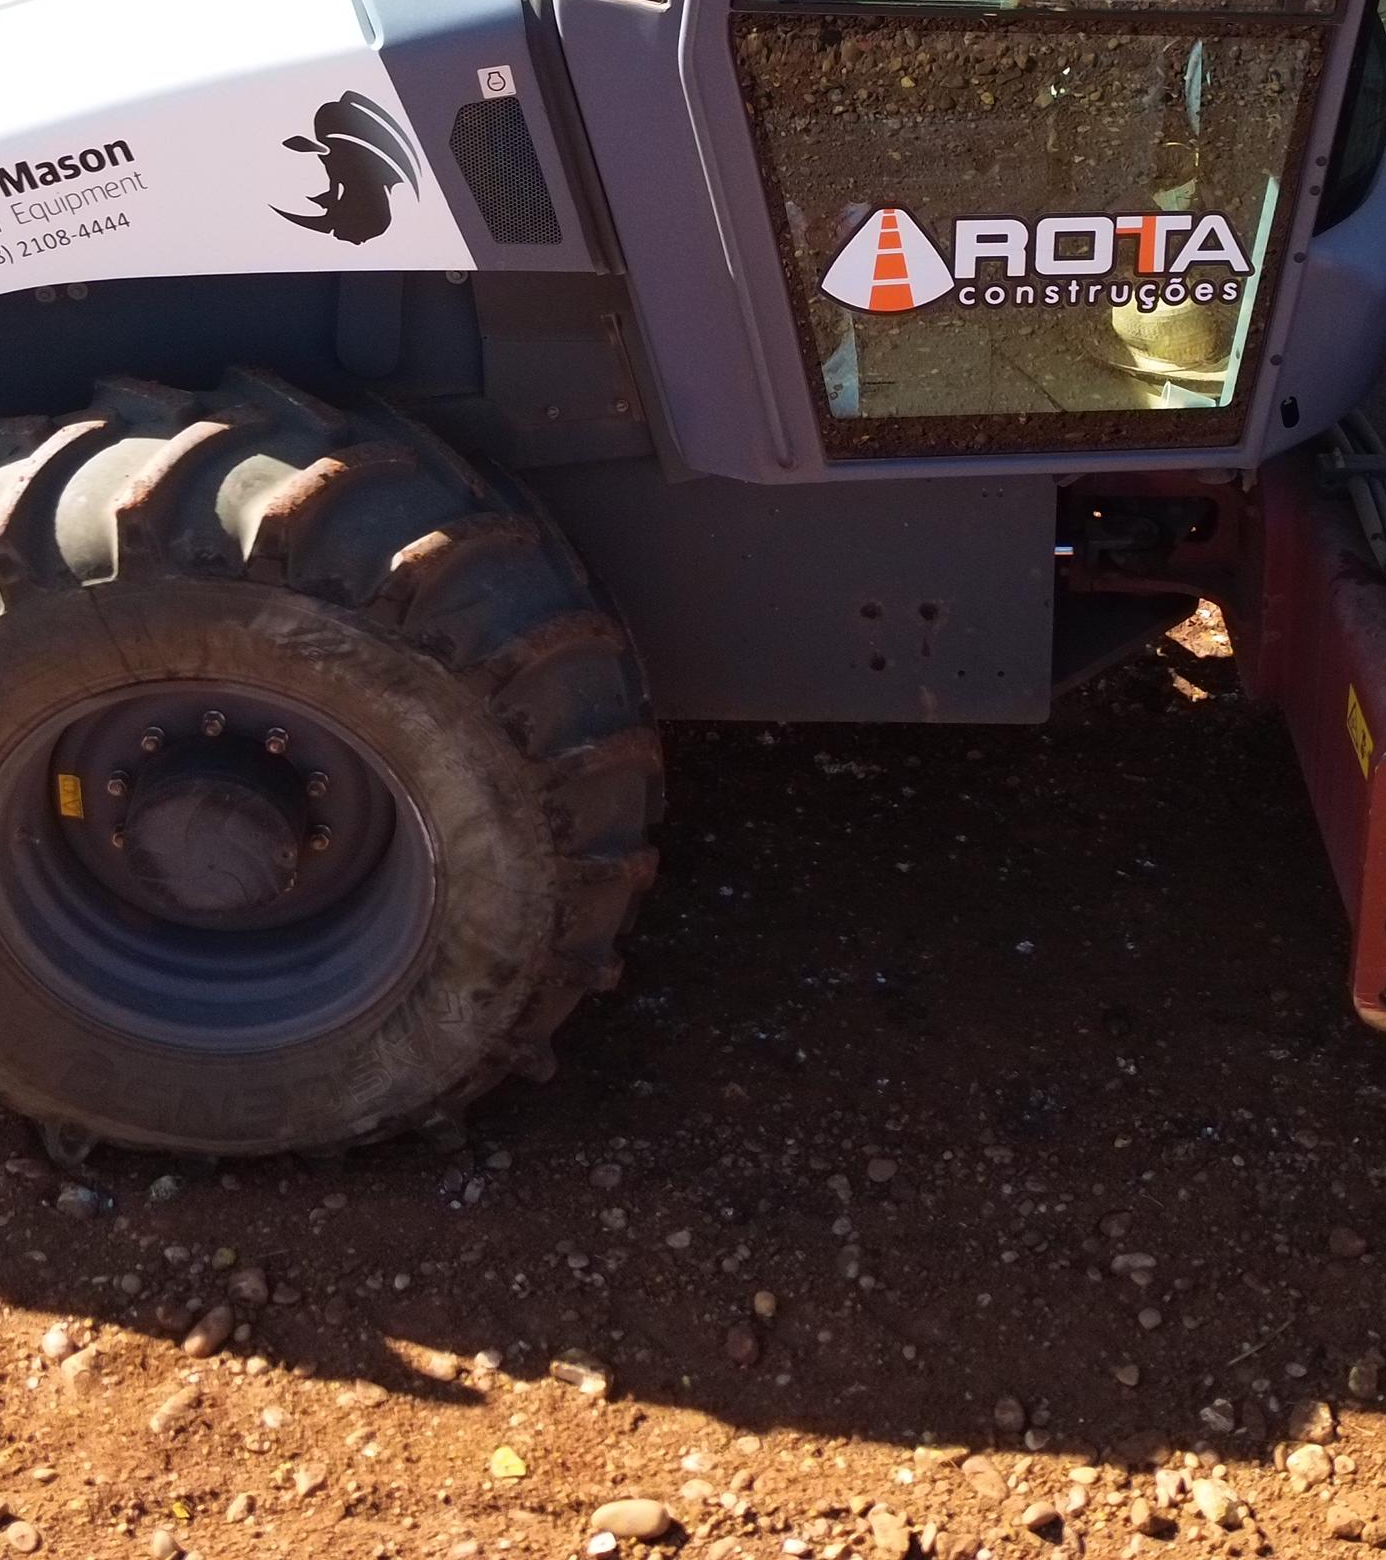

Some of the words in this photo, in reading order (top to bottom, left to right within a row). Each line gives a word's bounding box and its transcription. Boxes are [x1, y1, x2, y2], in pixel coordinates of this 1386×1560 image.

[9, 170, 148, 227] Equipment
[16, 211, 131, 258] 2108-4444
[954, 214, 1251, 278] ROTA
[957, 277, 1239, 309] construções
